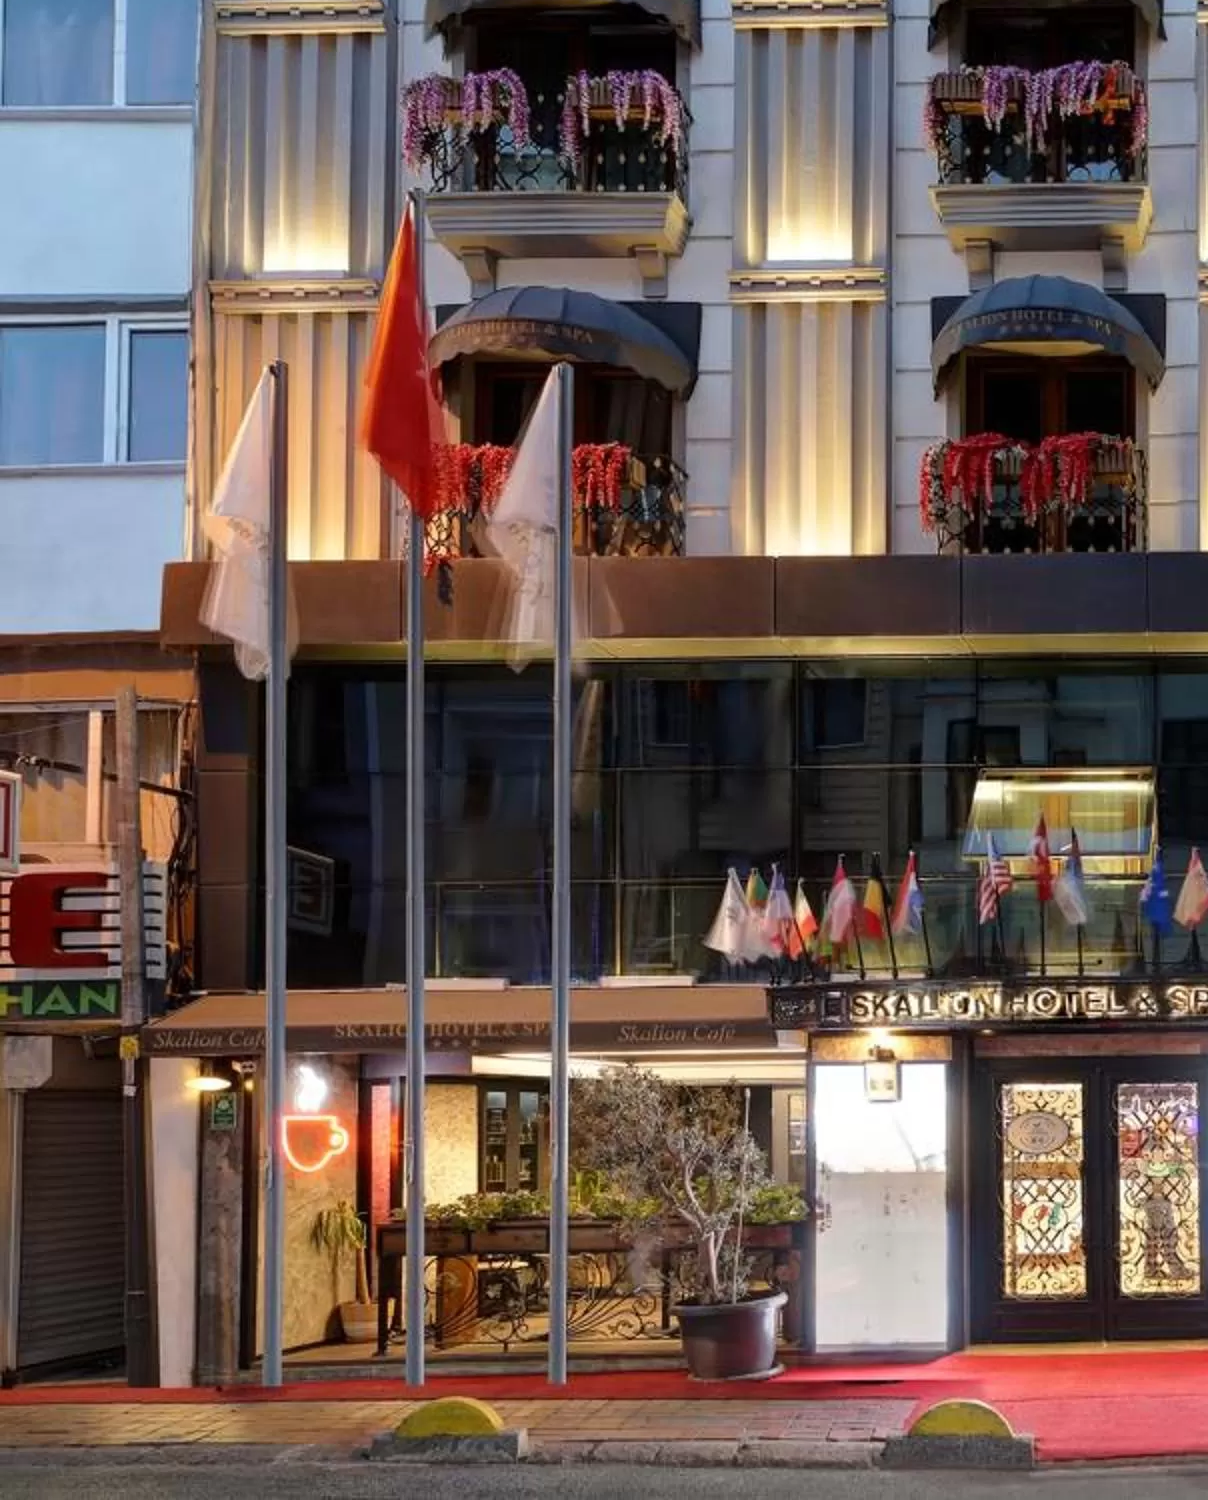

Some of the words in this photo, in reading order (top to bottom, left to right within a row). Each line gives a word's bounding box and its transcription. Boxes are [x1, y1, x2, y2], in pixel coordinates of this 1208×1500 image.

[851, 989, 1001, 1019] SKALION
[1008, 987, 1128, 1018] HOTEL
[1136, 990, 1159, 1017] &
[334, 1024, 409, 1038] SKALIO
[430, 1021, 497, 1037] HOTEL
[617, 1023, 687, 1044] Skalion
[153, 1030, 223, 1050] Skalion
